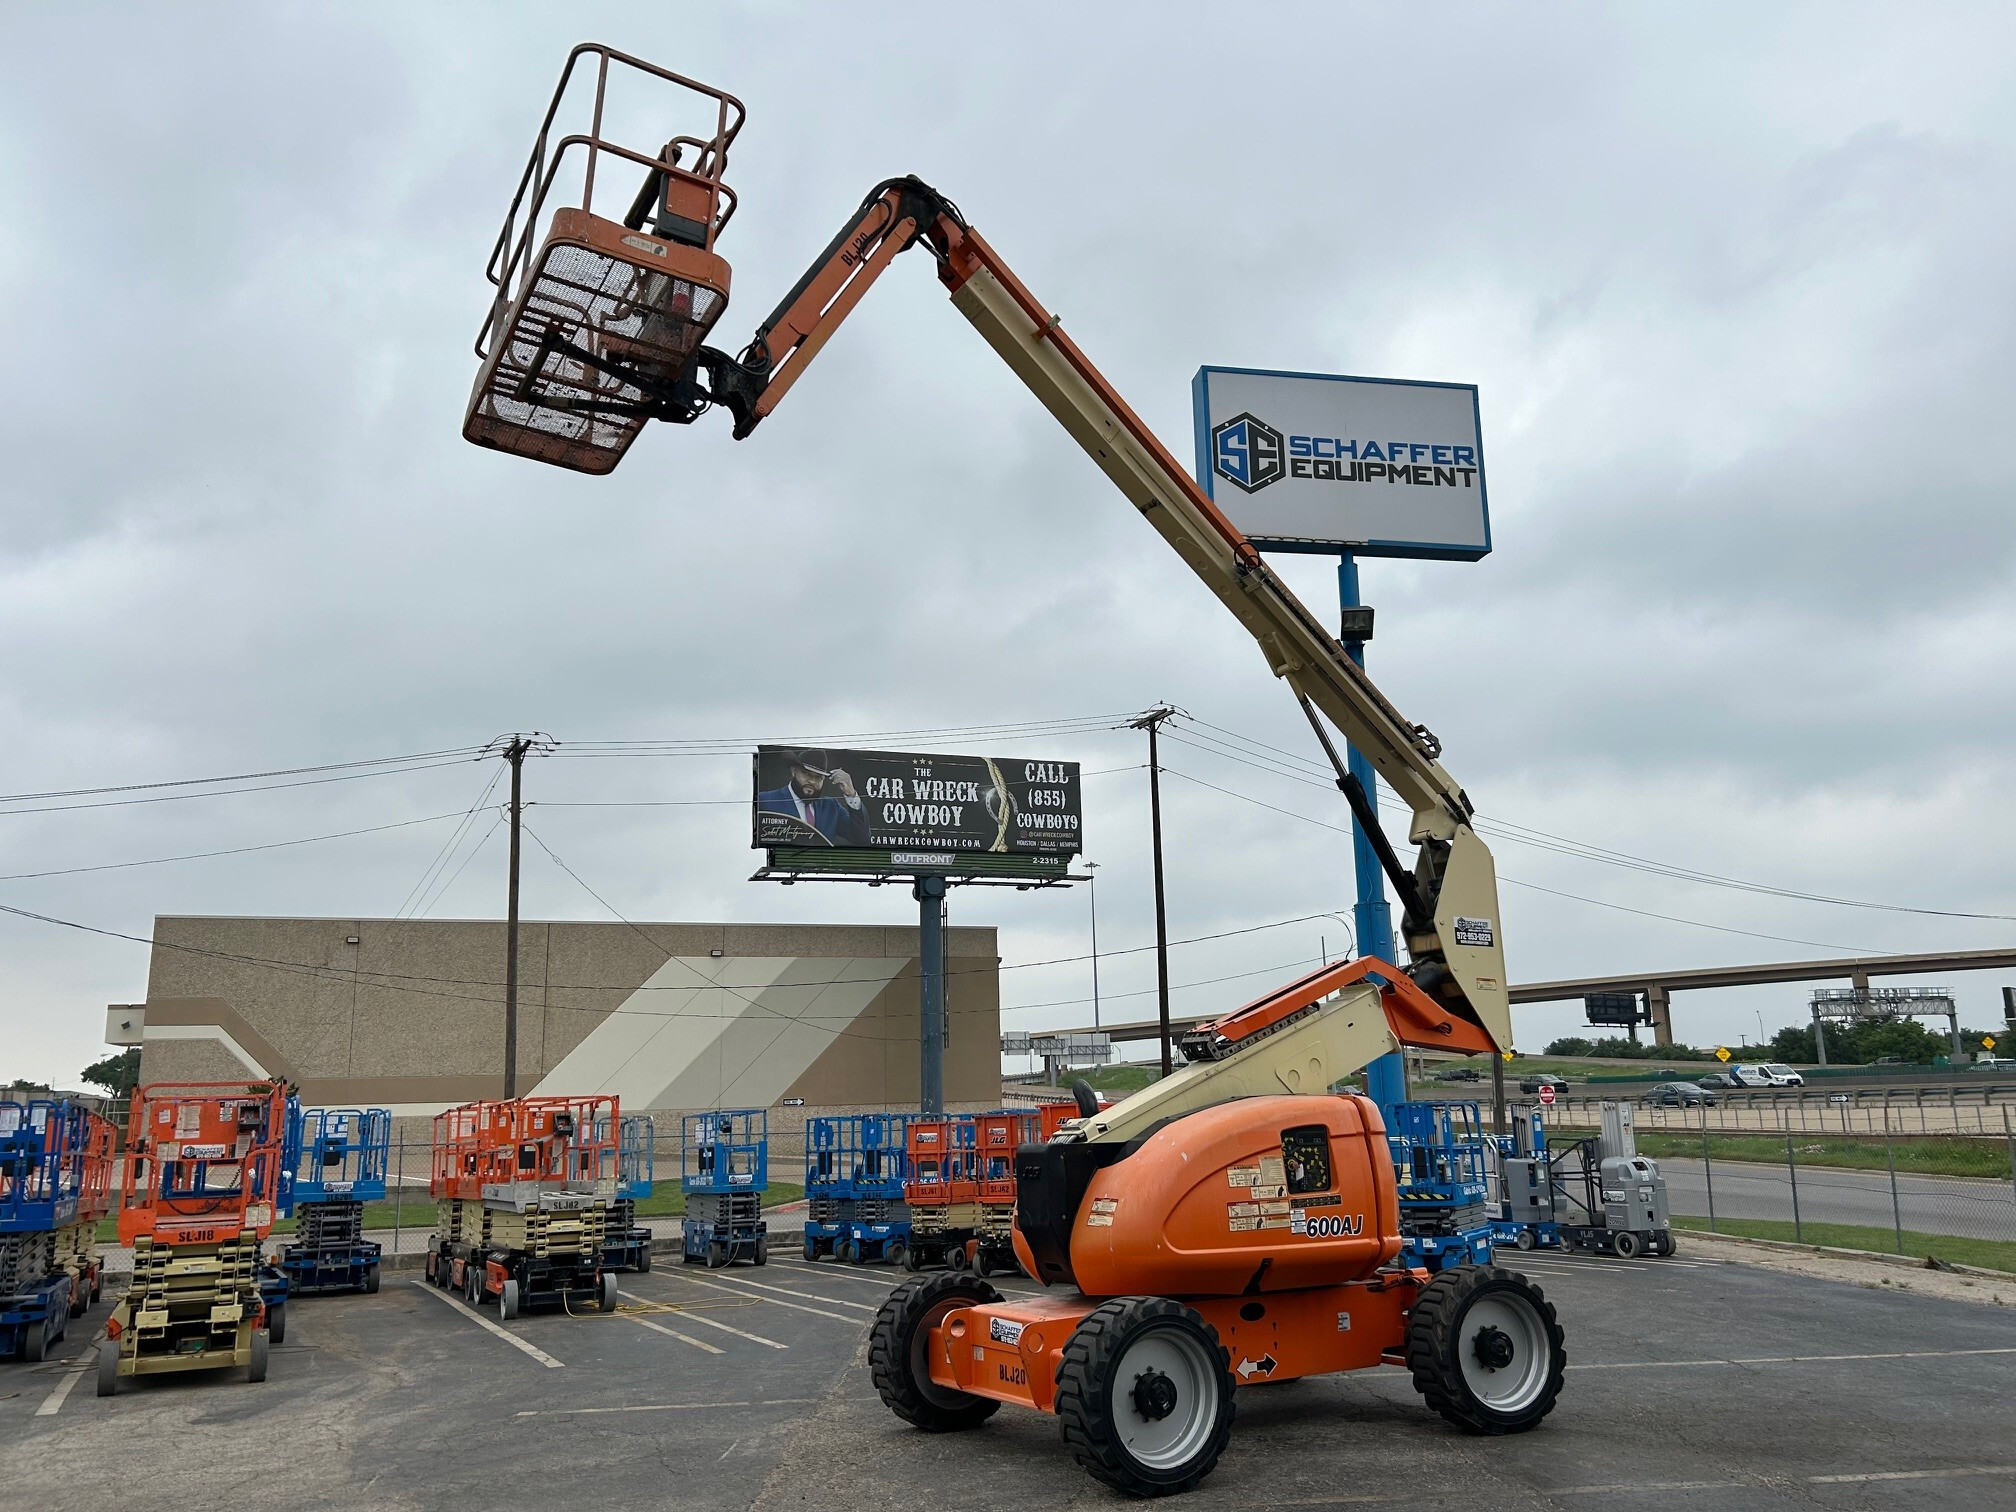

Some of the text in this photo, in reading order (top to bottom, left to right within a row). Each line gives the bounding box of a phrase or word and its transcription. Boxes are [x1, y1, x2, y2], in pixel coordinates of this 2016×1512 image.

[1289, 435, 1476, 466] SCHAFFER
[1290, 457, 1477, 488] EQUIPMENT
[914, 767, 932, 777] THE
[1025, 762, 1069, 784] CALL
[866, 777, 979, 803] CAR WRECK
[1028, 788, 1066, 810] (855)
[882, 802, 963, 827] COWBOY
[1016, 812, 1078, 830] COWBOY9
[870, 836, 981, 848] CARWRECKCOWBOY.COM
[893, 854, 952, 864] OUTFRONT
[1032, 857, 1059, 865] 2-2315
[990, 1136, 1006, 1144] JLG
[1306, 1214, 1363, 1238] 600AJ
[999, 1363, 1026, 1386] BLJ20
